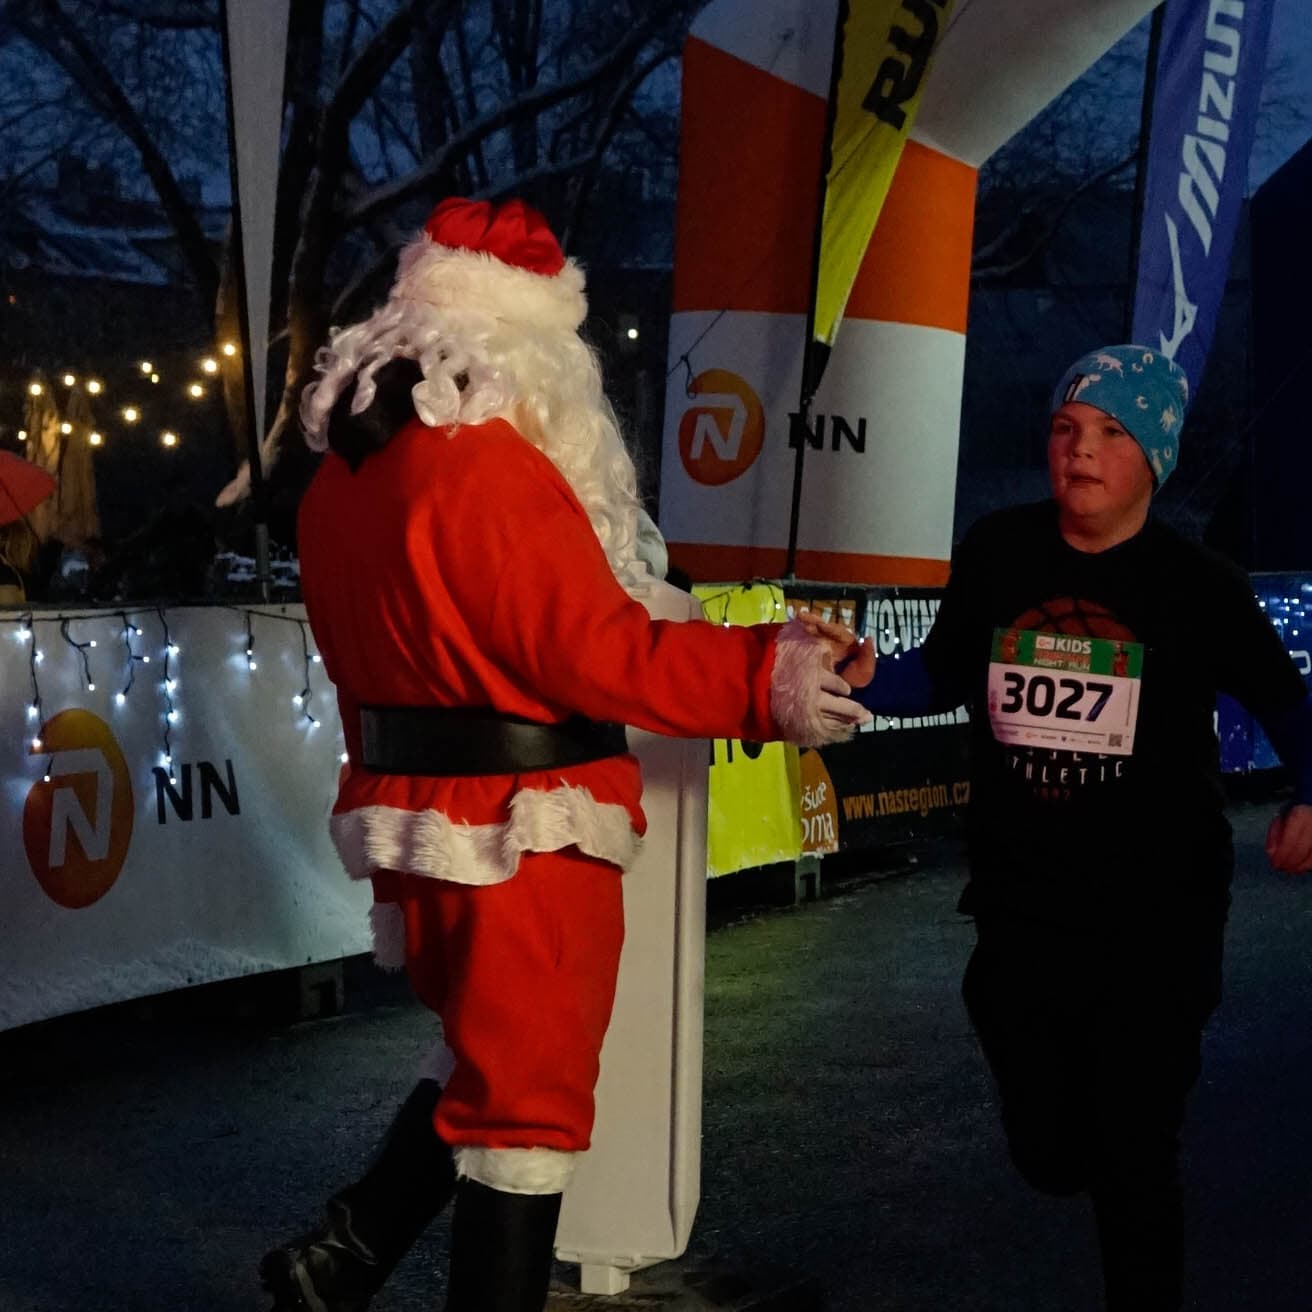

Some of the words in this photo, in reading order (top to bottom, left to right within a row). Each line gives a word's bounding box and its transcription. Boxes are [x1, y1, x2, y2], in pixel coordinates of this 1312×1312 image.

[1056, 637, 1093, 655] KIDS
[1001, 672, 1114, 722] 3027
[152, 759, 240, 825] NN
